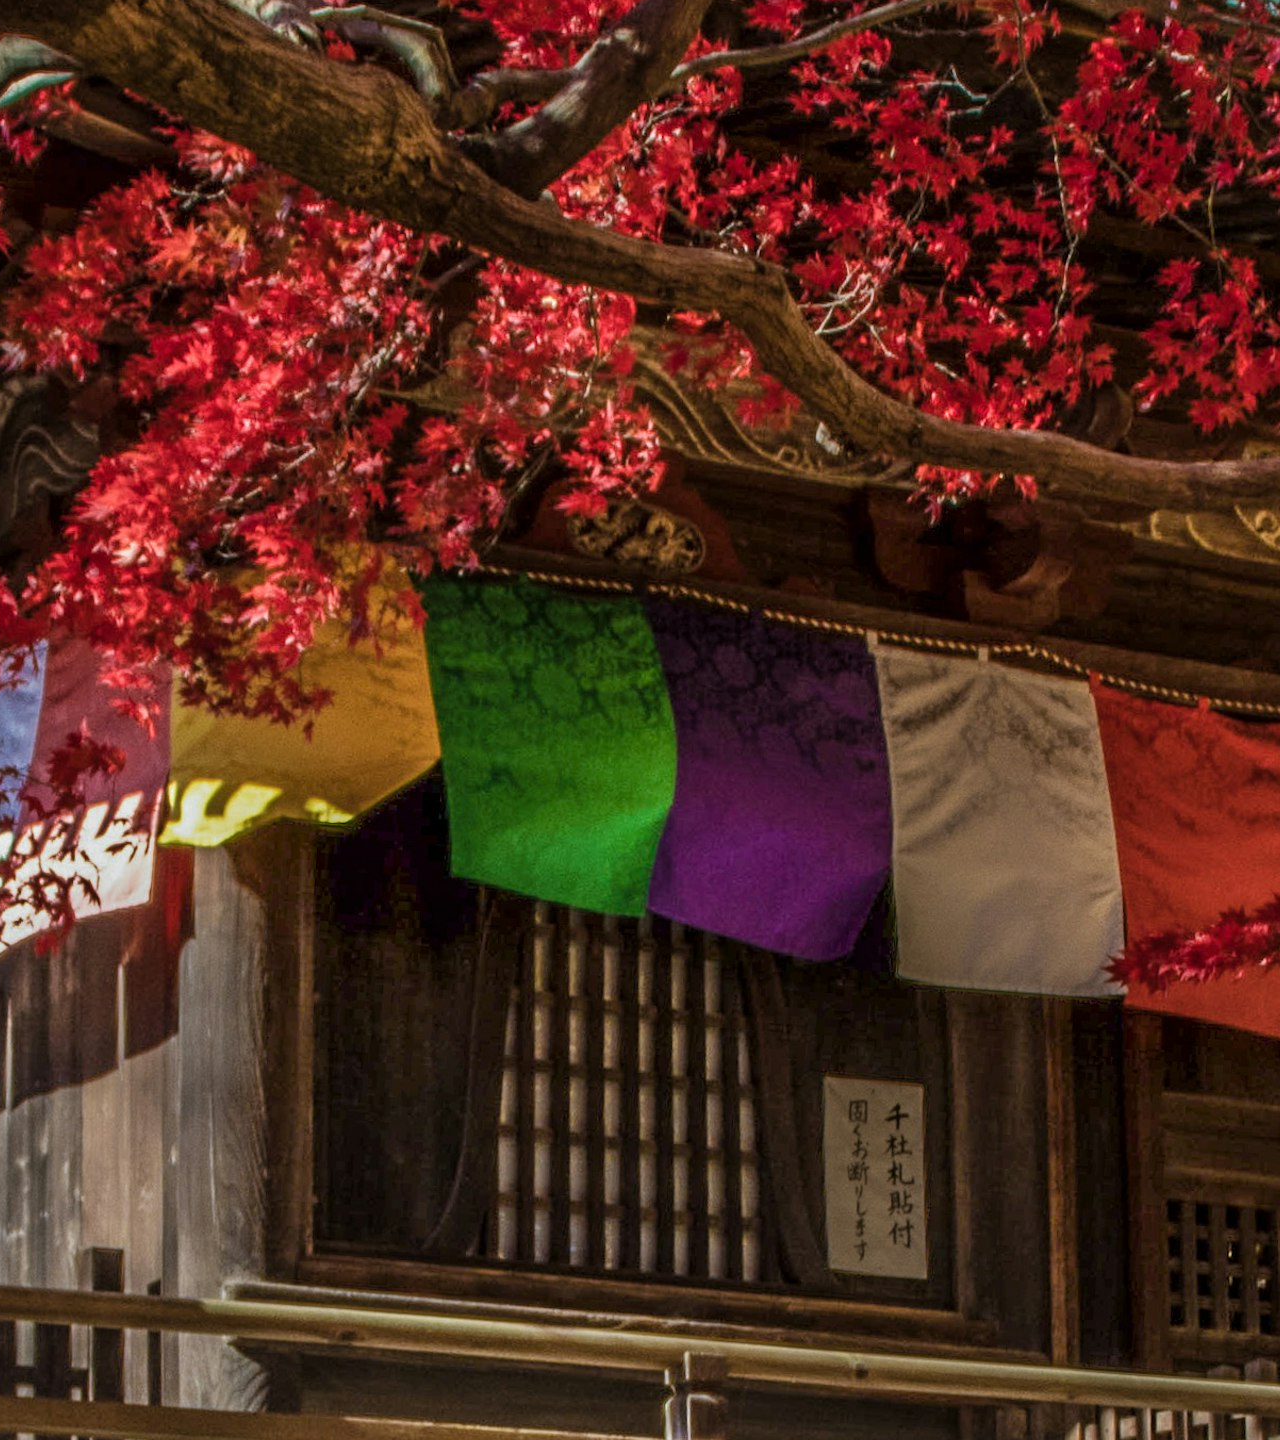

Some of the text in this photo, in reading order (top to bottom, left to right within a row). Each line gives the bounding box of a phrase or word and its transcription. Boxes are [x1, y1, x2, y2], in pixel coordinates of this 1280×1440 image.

[847, 1099, 870, 1263] 固くお断りします
